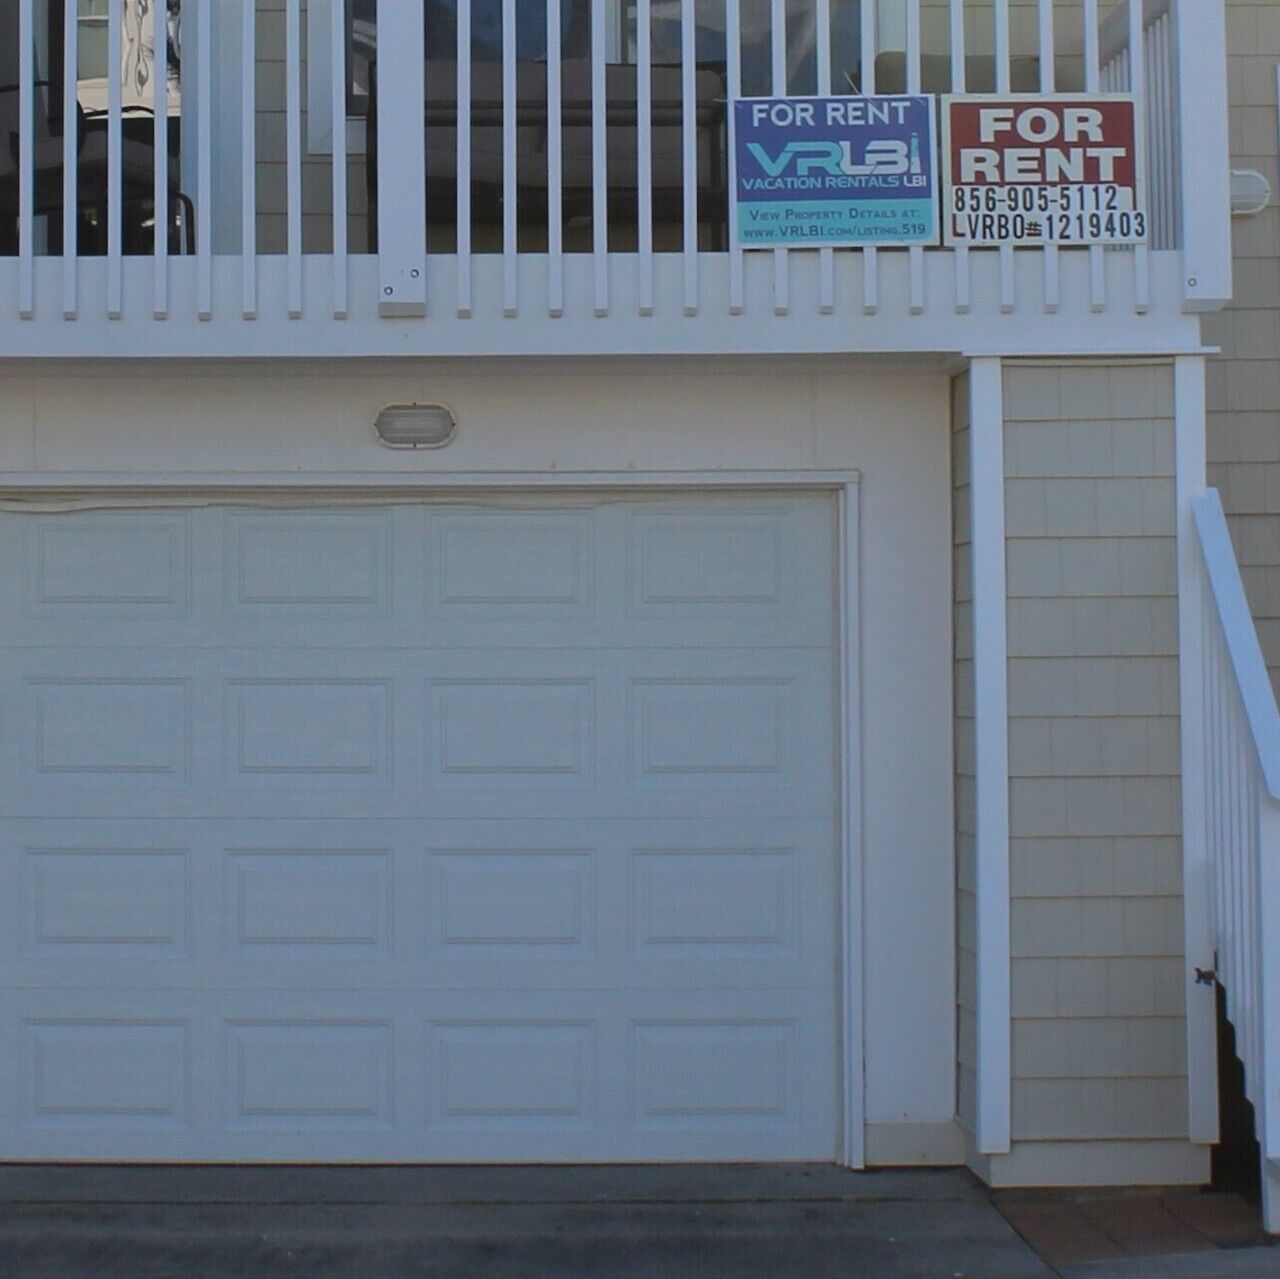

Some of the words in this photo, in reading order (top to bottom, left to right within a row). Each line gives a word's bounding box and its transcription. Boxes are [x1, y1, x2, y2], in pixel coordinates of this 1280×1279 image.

[752, 103, 815, 127] FOR
[826, 101, 911, 125] RENT
[979, 107, 1104, 143] FOR
[960, 147, 1126, 183] RENT
[742, 176, 821, 190] VACATION
[825, 175, 899, 189] RENTALS
[903, 175, 926, 187] LBI
[954, 186, 1117, 212] 856-905-5112
